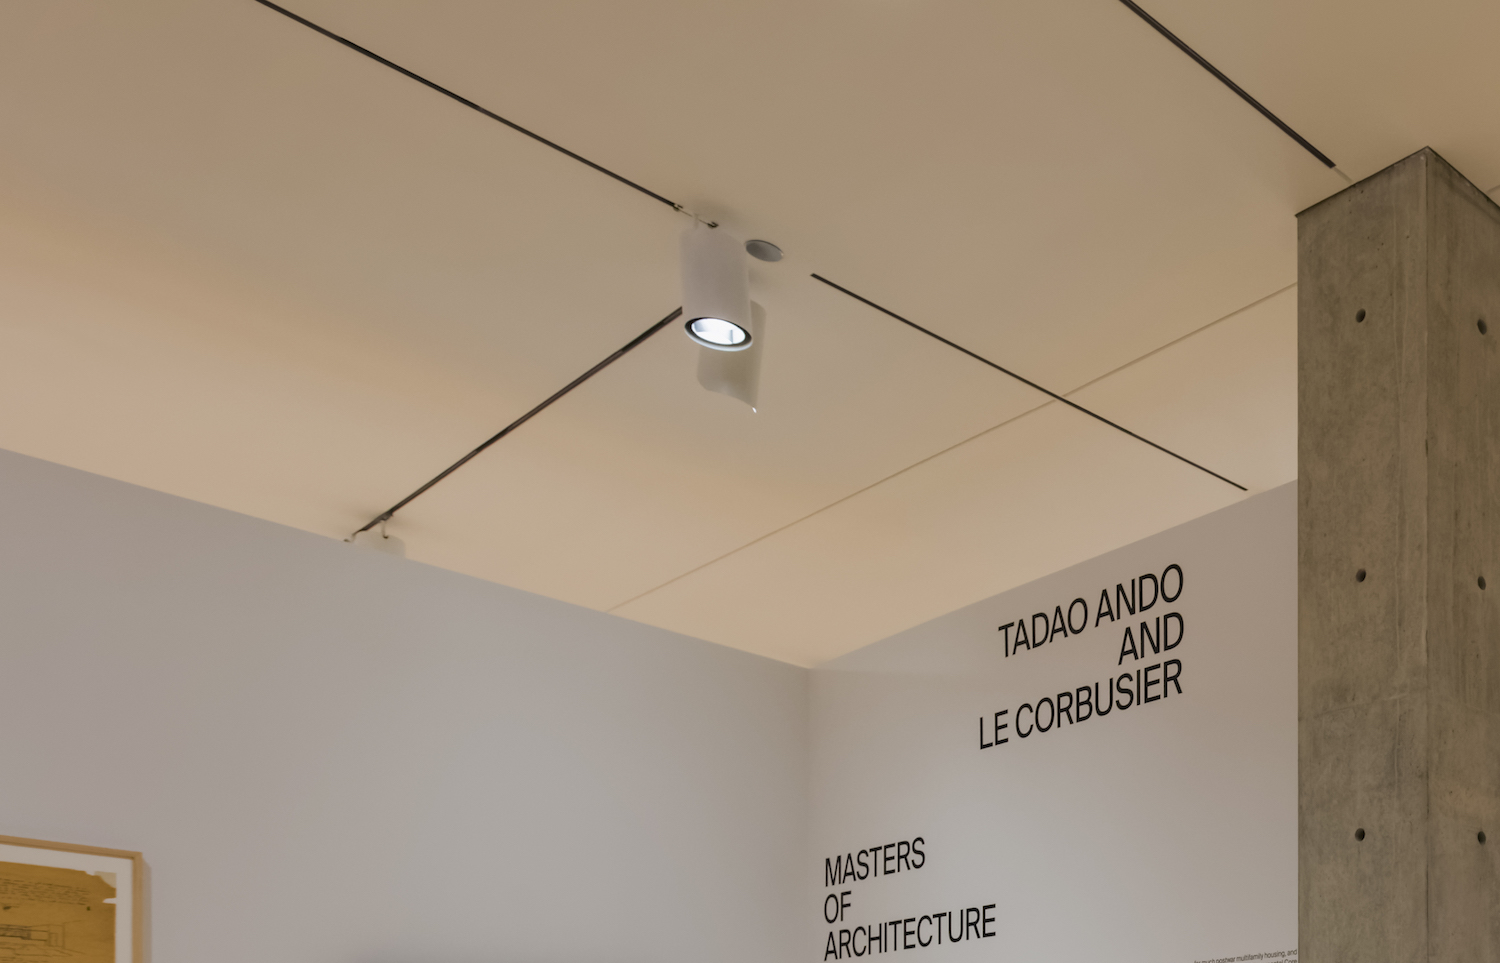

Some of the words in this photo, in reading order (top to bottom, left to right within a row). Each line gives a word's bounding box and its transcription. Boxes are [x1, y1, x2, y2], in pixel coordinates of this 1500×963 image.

[998, 597, 1089, 658] TADAO
[1094, 563, 1184, 628] ANDO
[1117, 611, 1185, 666] AND
[979, 709, 1009, 750] LE
[1015, 658, 1183, 739] CORBUSIER
[825, 836, 926, 888] MASTERS
[823, 890, 852, 924] OF
[823, 903, 996, 962] ARCHITECTURE
[1236, 952, 1264, 963] multifamily
[1286, 948, 1298, 956] and
